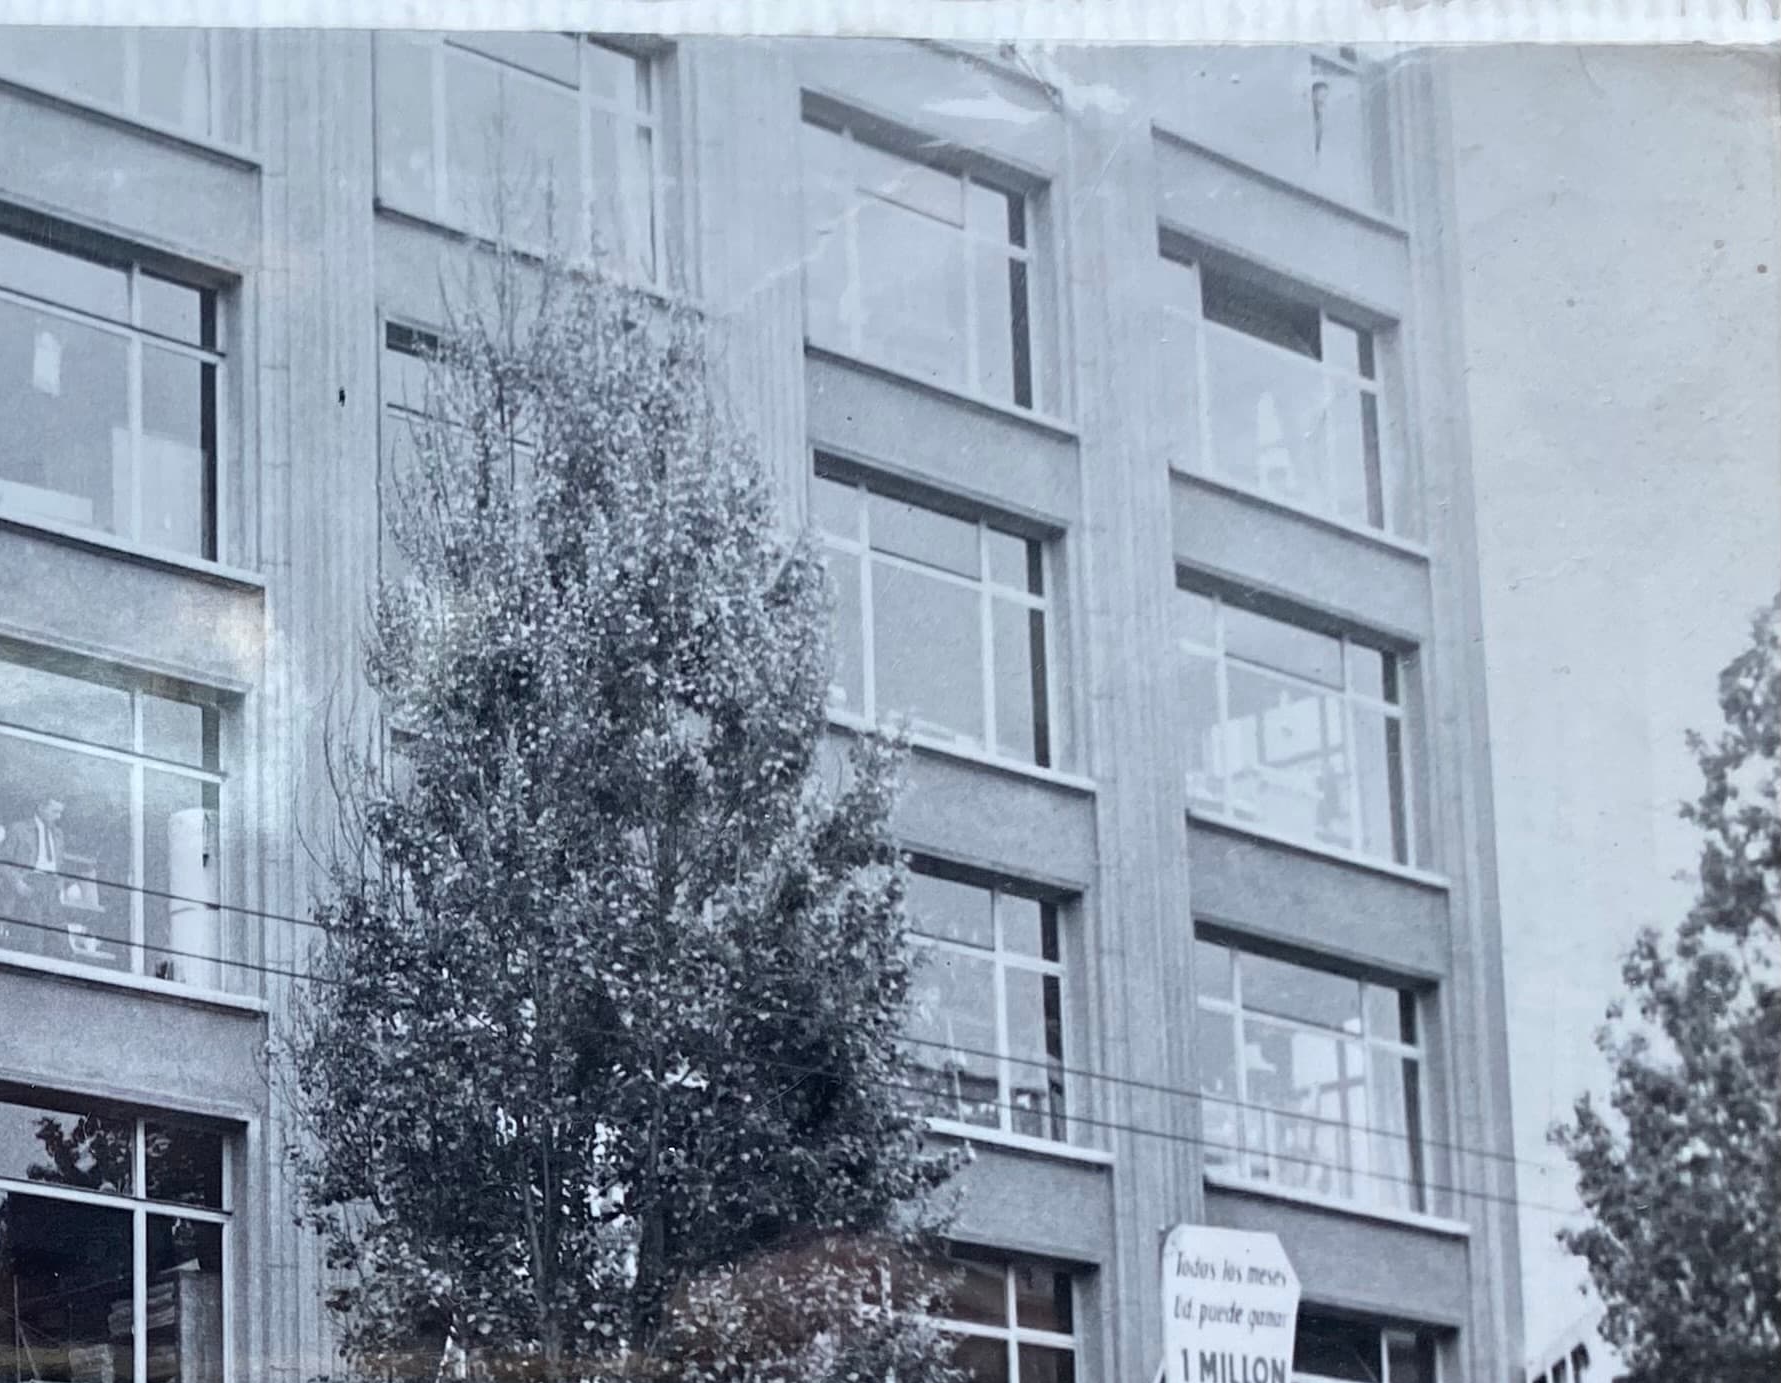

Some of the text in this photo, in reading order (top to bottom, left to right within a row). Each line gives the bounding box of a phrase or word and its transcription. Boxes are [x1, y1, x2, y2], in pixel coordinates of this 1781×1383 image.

[1175, 1251, 1287, 1288] Todos los meses
[1198, 1300, 1243, 1330] puede
[1247, 1309, 1287, 1334] ganar
[1181, 1348, 1190, 1382] 1
